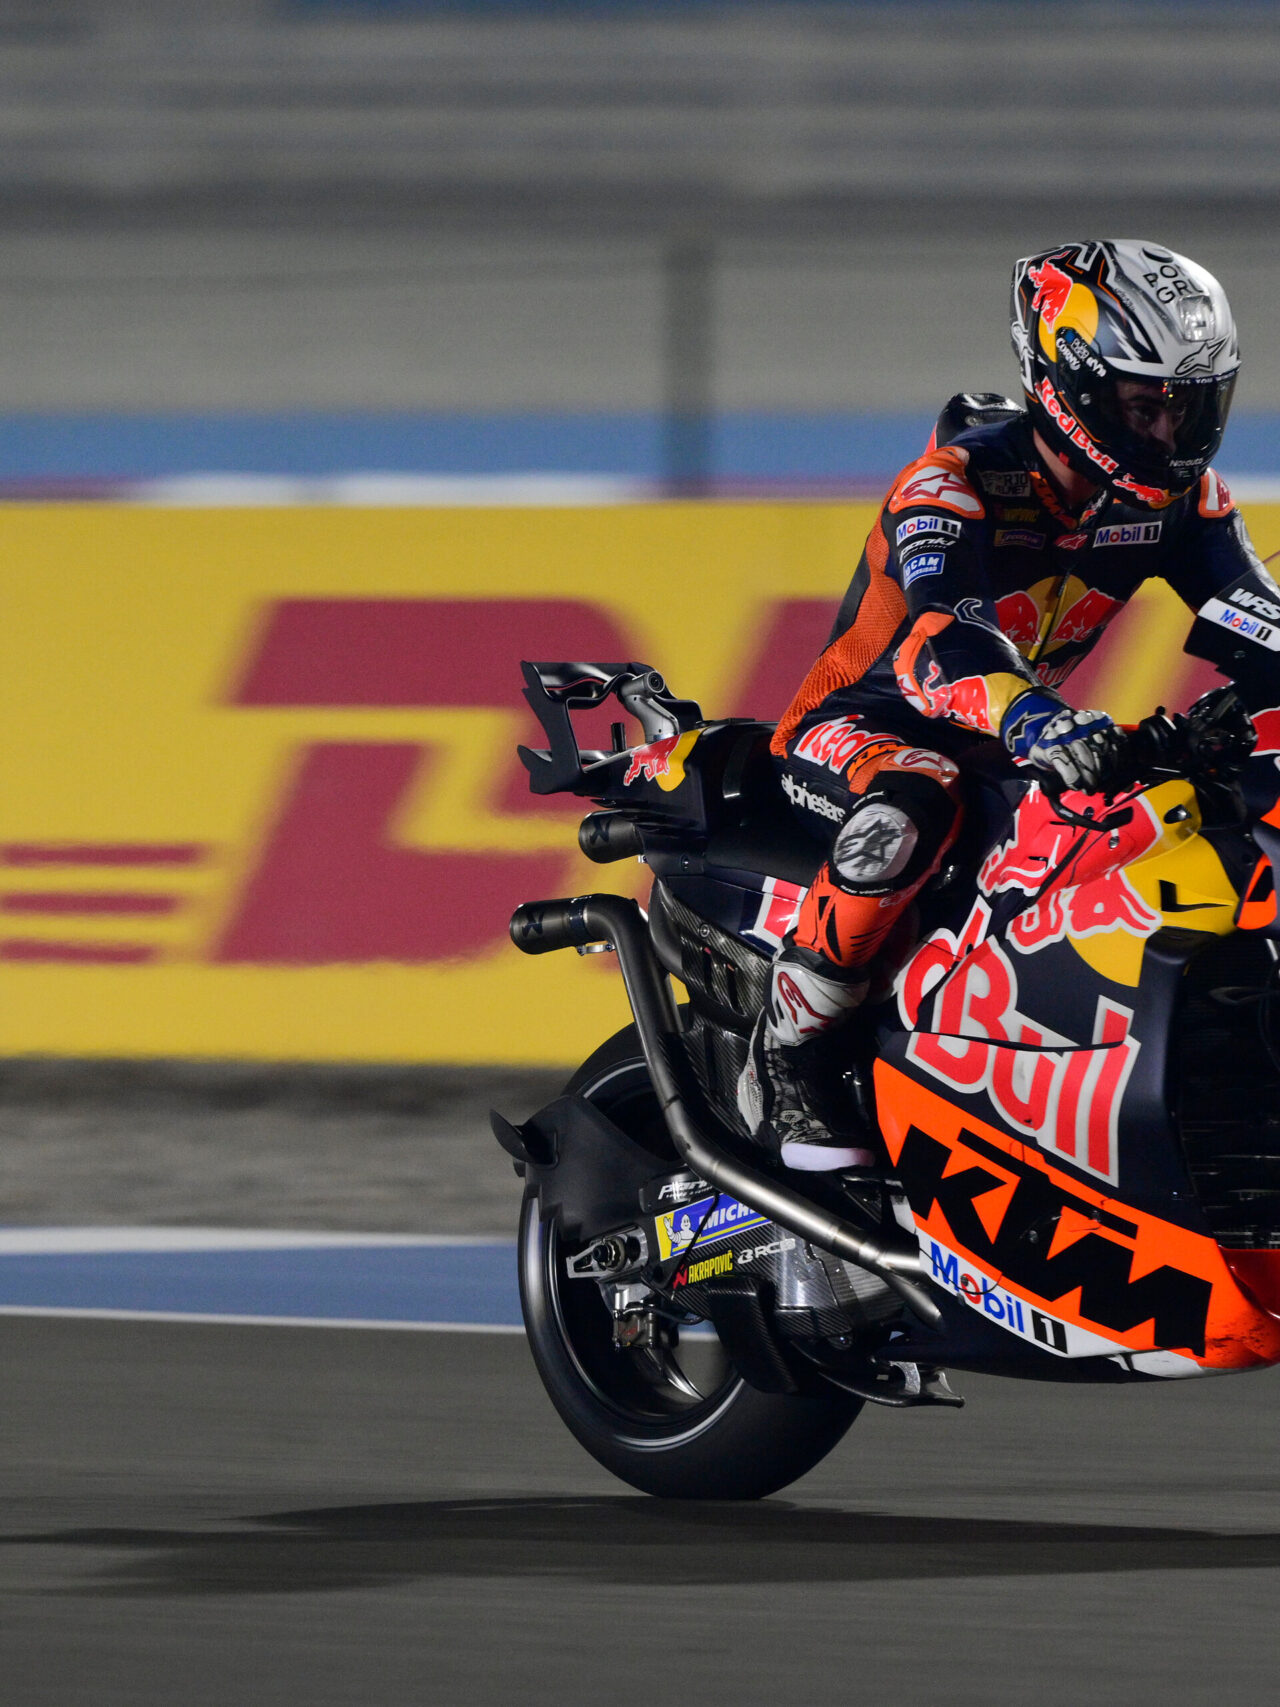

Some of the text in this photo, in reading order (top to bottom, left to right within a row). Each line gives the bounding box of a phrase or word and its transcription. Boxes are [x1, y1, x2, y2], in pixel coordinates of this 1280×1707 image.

[1034, 378, 1075, 434] Red
[1069, 428, 1120, 474] Bull
[898, 518, 938, 539] Mobil
[1096, 526, 1141, 544] Mobil
[1220, 609, 1259, 635] Mobil
[793, 714, 906, 775] Red
[781, 773, 846, 825] alpinestars
[905, 935, 1141, 1188] Bull
[699, 1203, 757, 1231] MICH
[899, 1124, 1213, 1357] KTM
[930, 1241, 1025, 1333] Mobil
